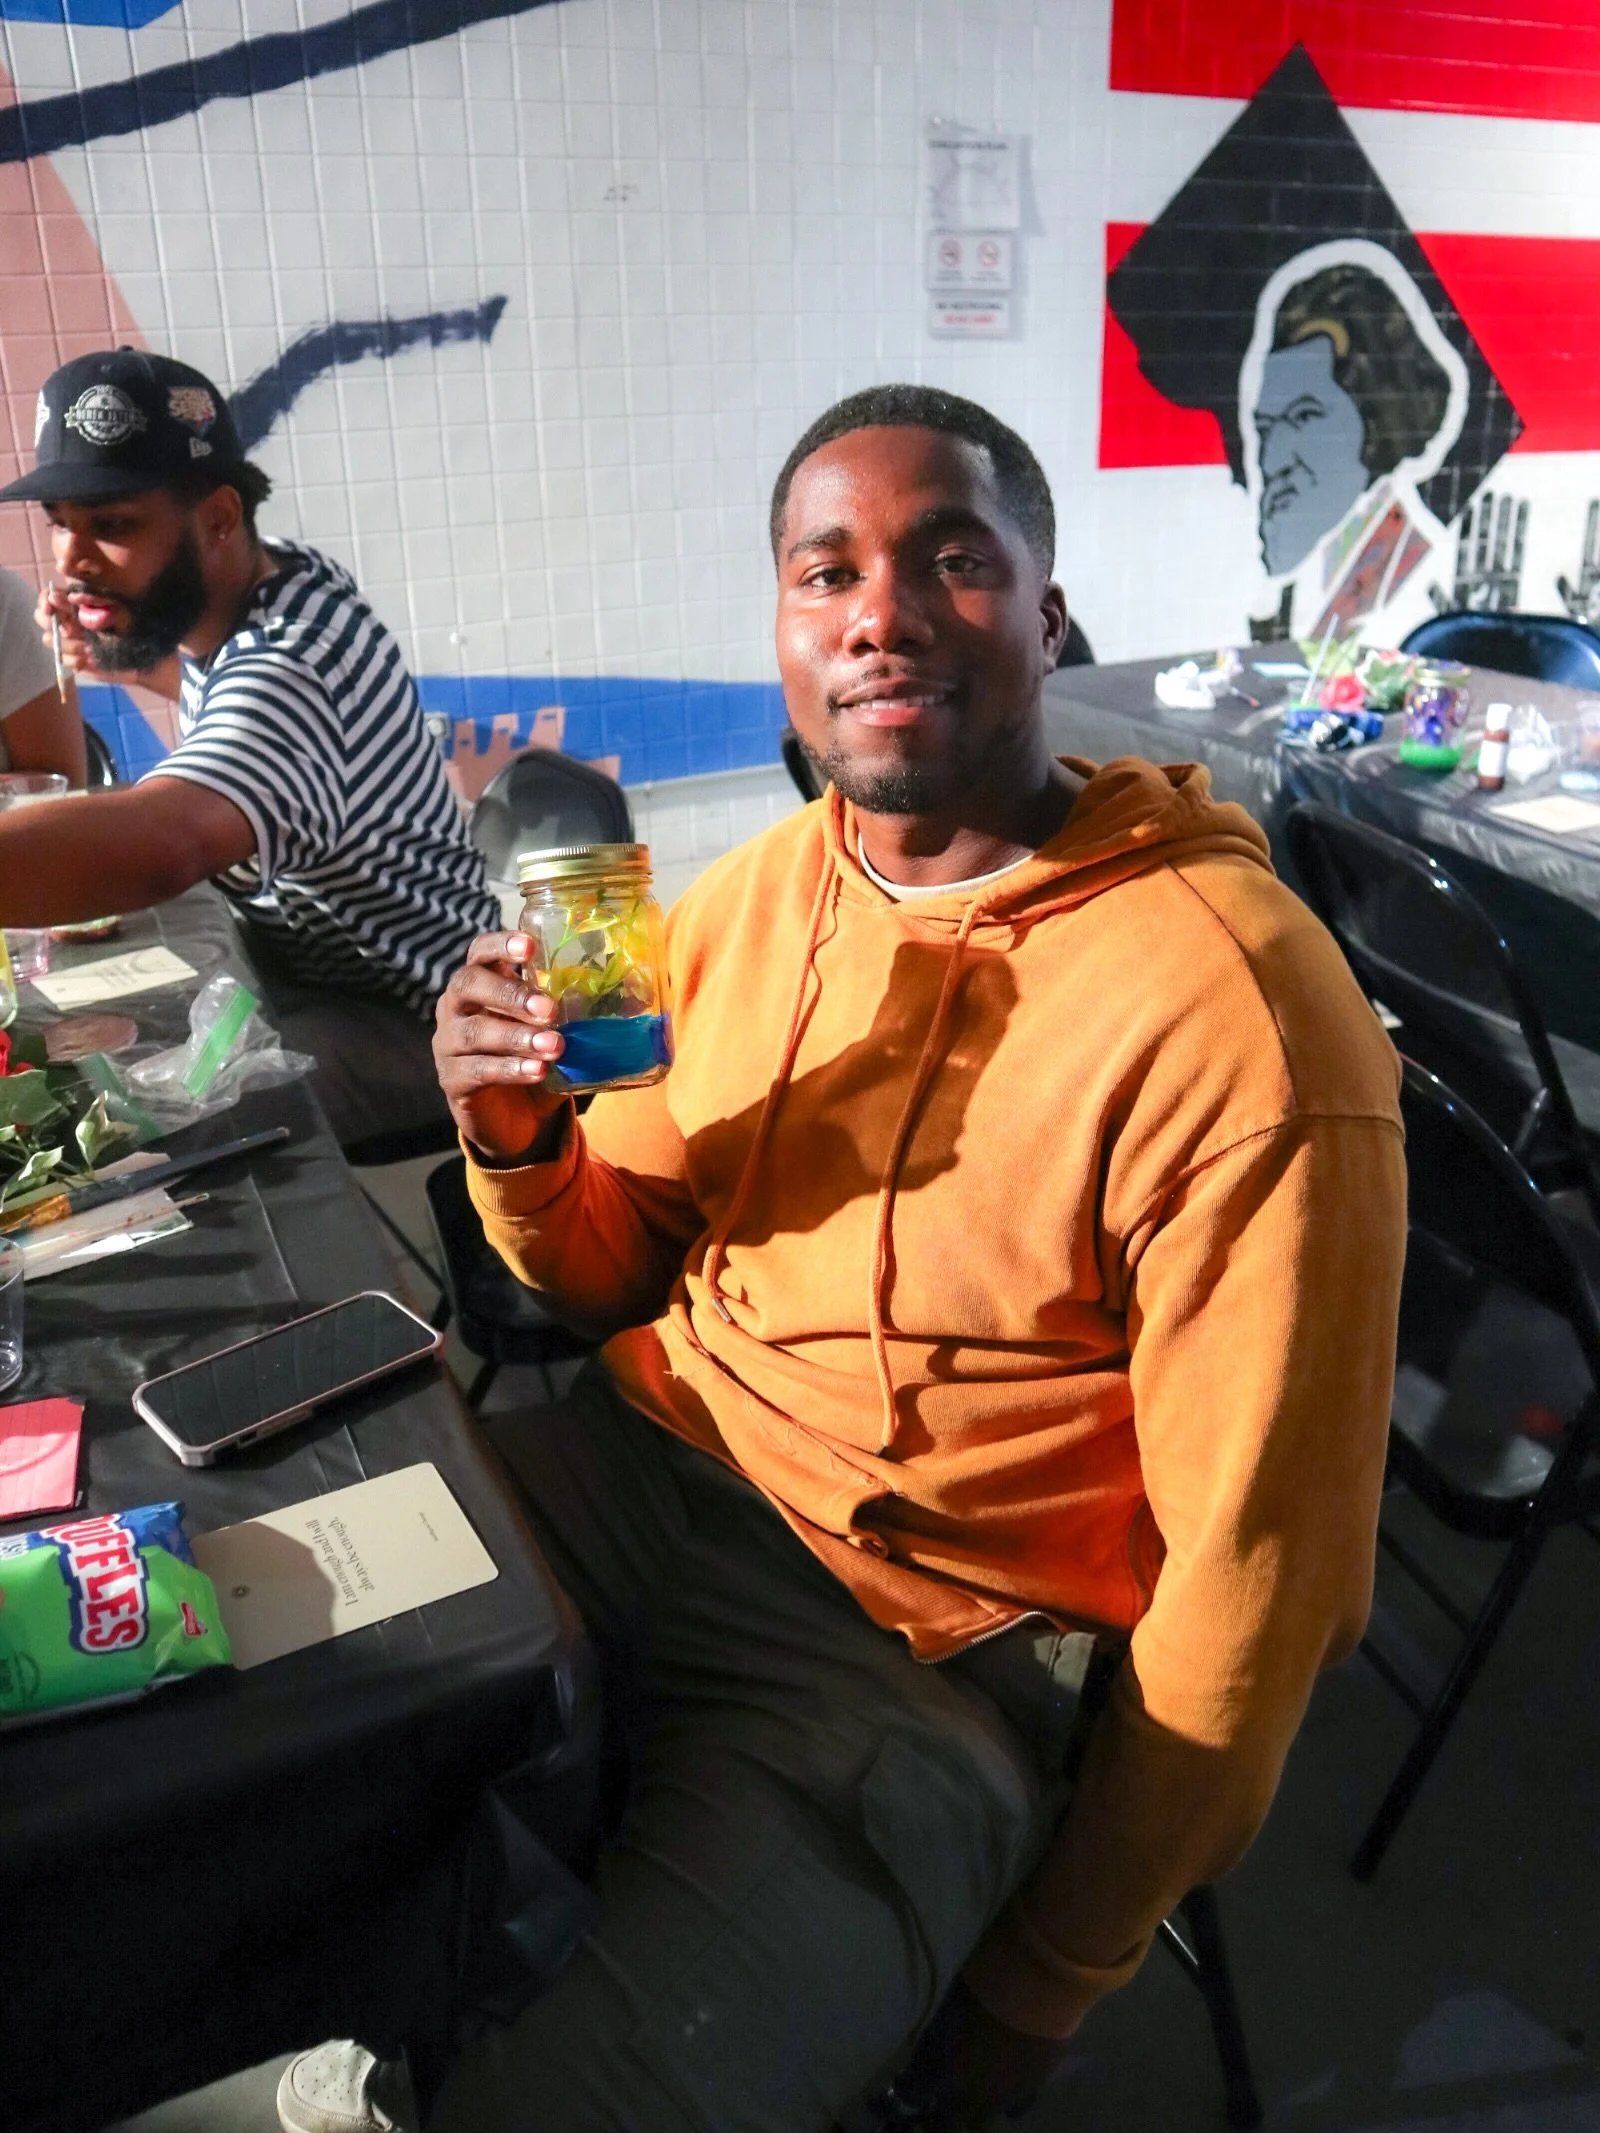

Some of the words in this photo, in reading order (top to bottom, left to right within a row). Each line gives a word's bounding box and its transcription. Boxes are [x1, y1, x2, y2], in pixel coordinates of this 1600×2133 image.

[305, 1519, 324, 1535] will
[316, 1537, 335, 1555] and
[347, 1550, 360, 1564] be
[324, 1555, 349, 1584] enough
[353, 1562, 376, 1591] always
[342, 1584, 356, 1600] am
